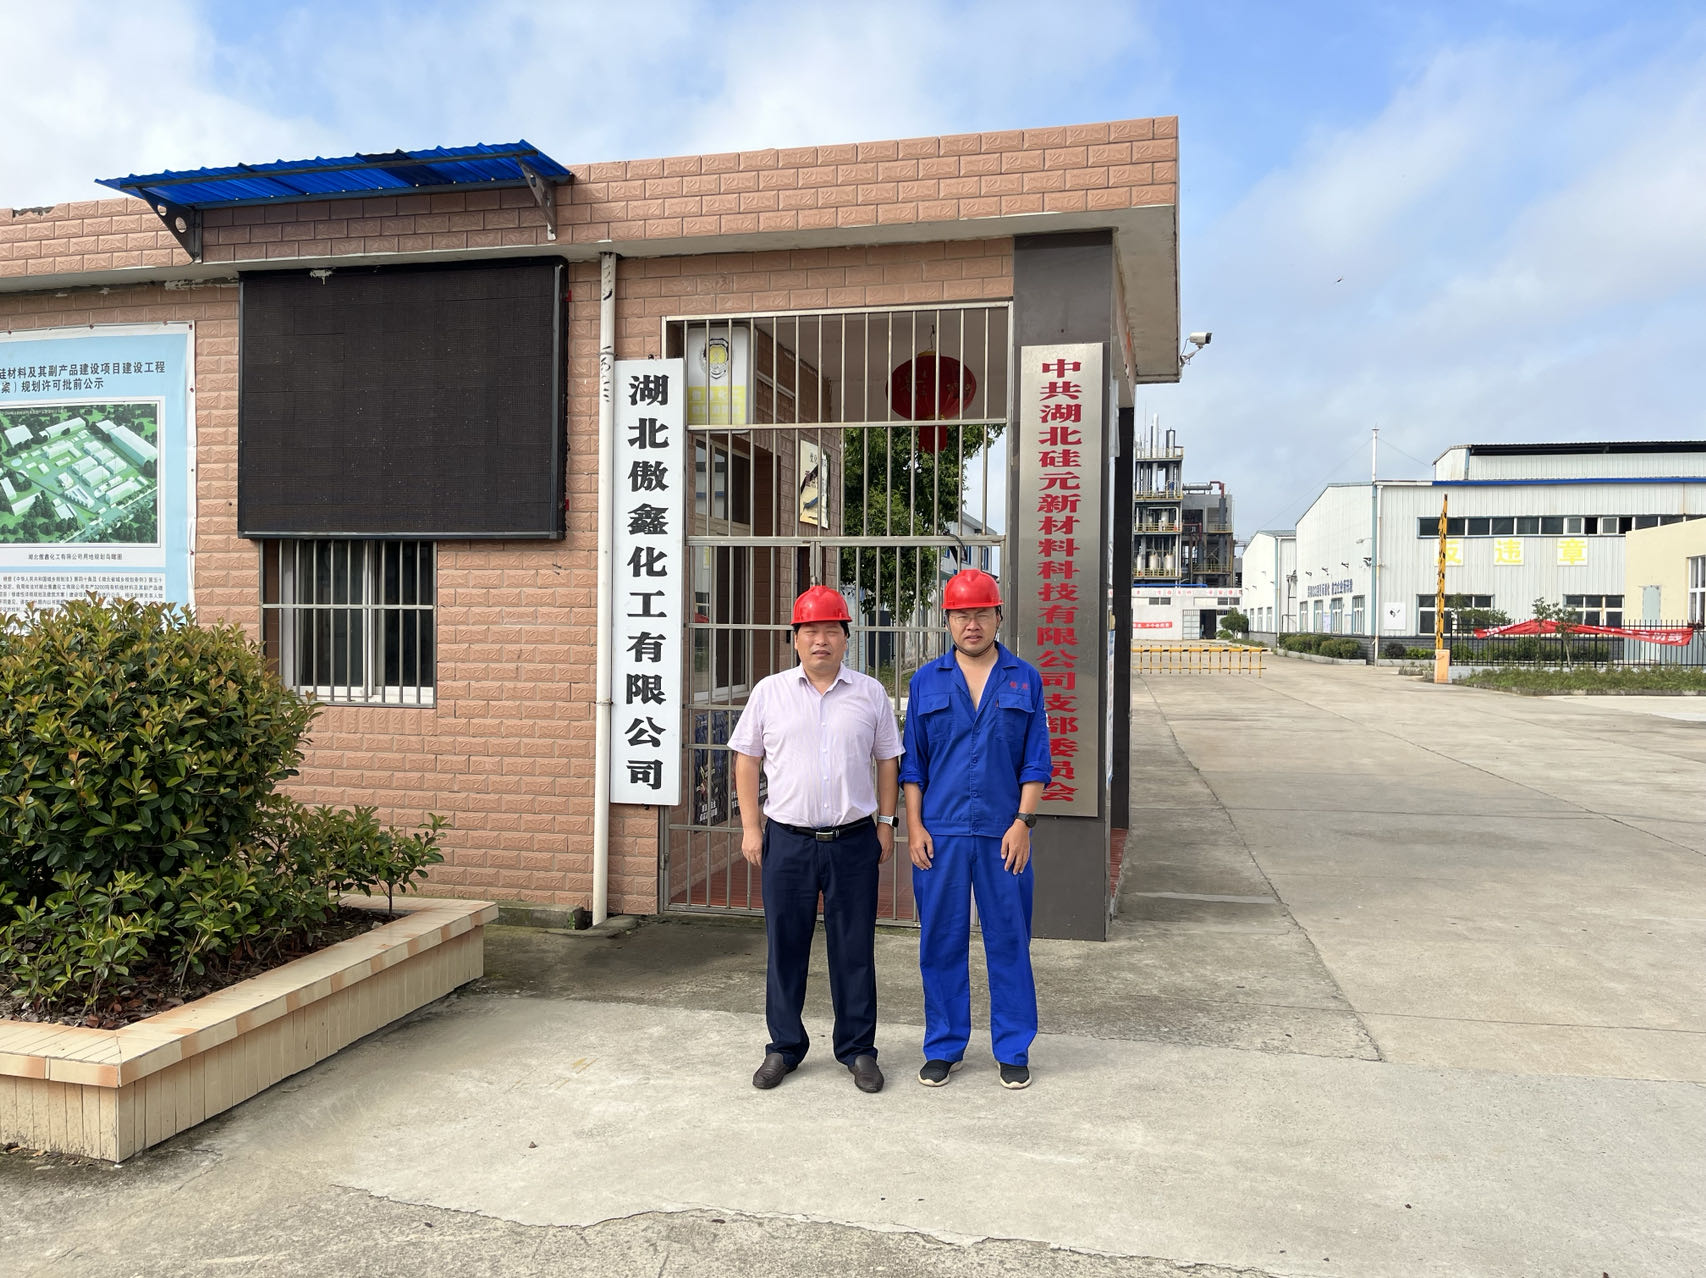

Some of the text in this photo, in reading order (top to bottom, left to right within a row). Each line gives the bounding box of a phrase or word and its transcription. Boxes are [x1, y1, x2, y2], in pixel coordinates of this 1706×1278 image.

[624, 374, 670, 790] 湖北傲鑫化工有限公司
[1036, 358, 1083, 802] 中共湖北硅元新材料科技有限公司支部委员会
